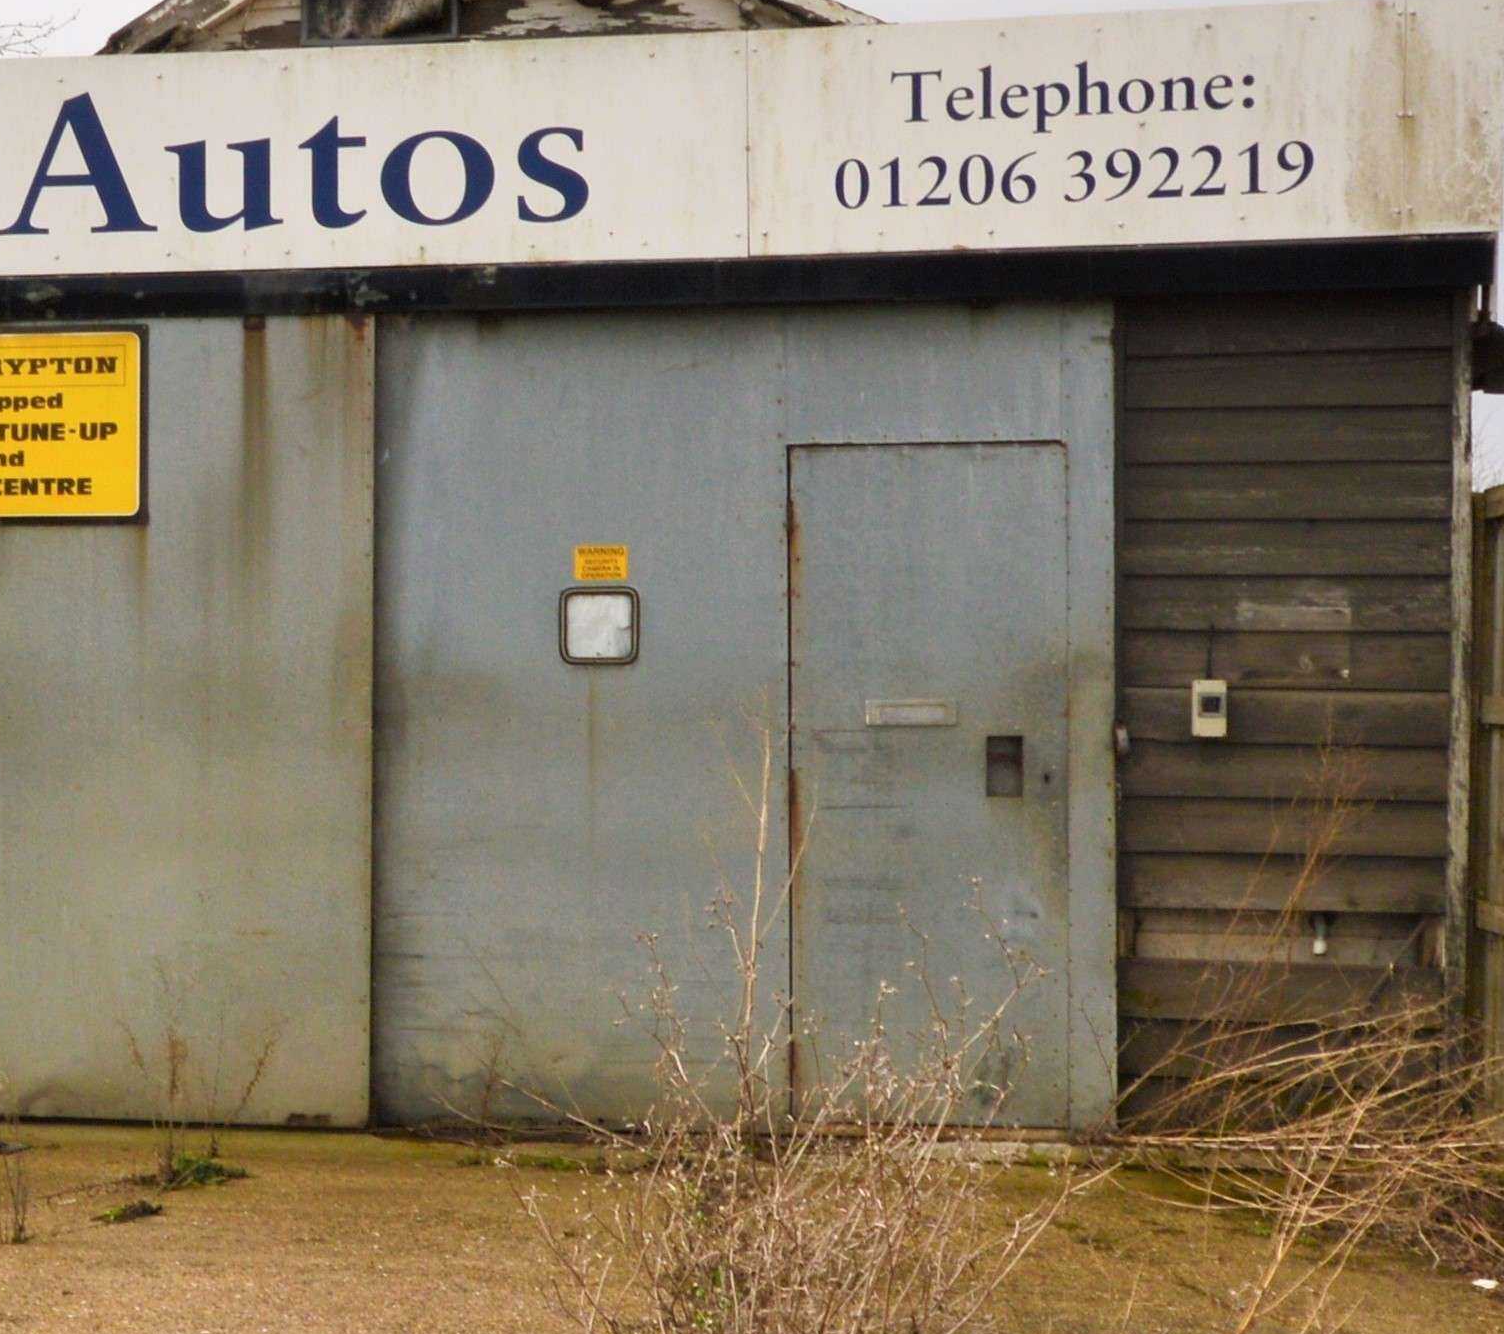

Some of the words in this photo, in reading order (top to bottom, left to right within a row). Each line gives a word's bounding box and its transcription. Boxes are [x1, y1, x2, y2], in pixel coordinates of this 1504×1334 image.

[890, 60, 1256, 134] Telephone:
[834, 151, 1038, 210] 01206
[1063, 140, 1315, 203] 392219
[577, 546, 625, 556] WARNING
